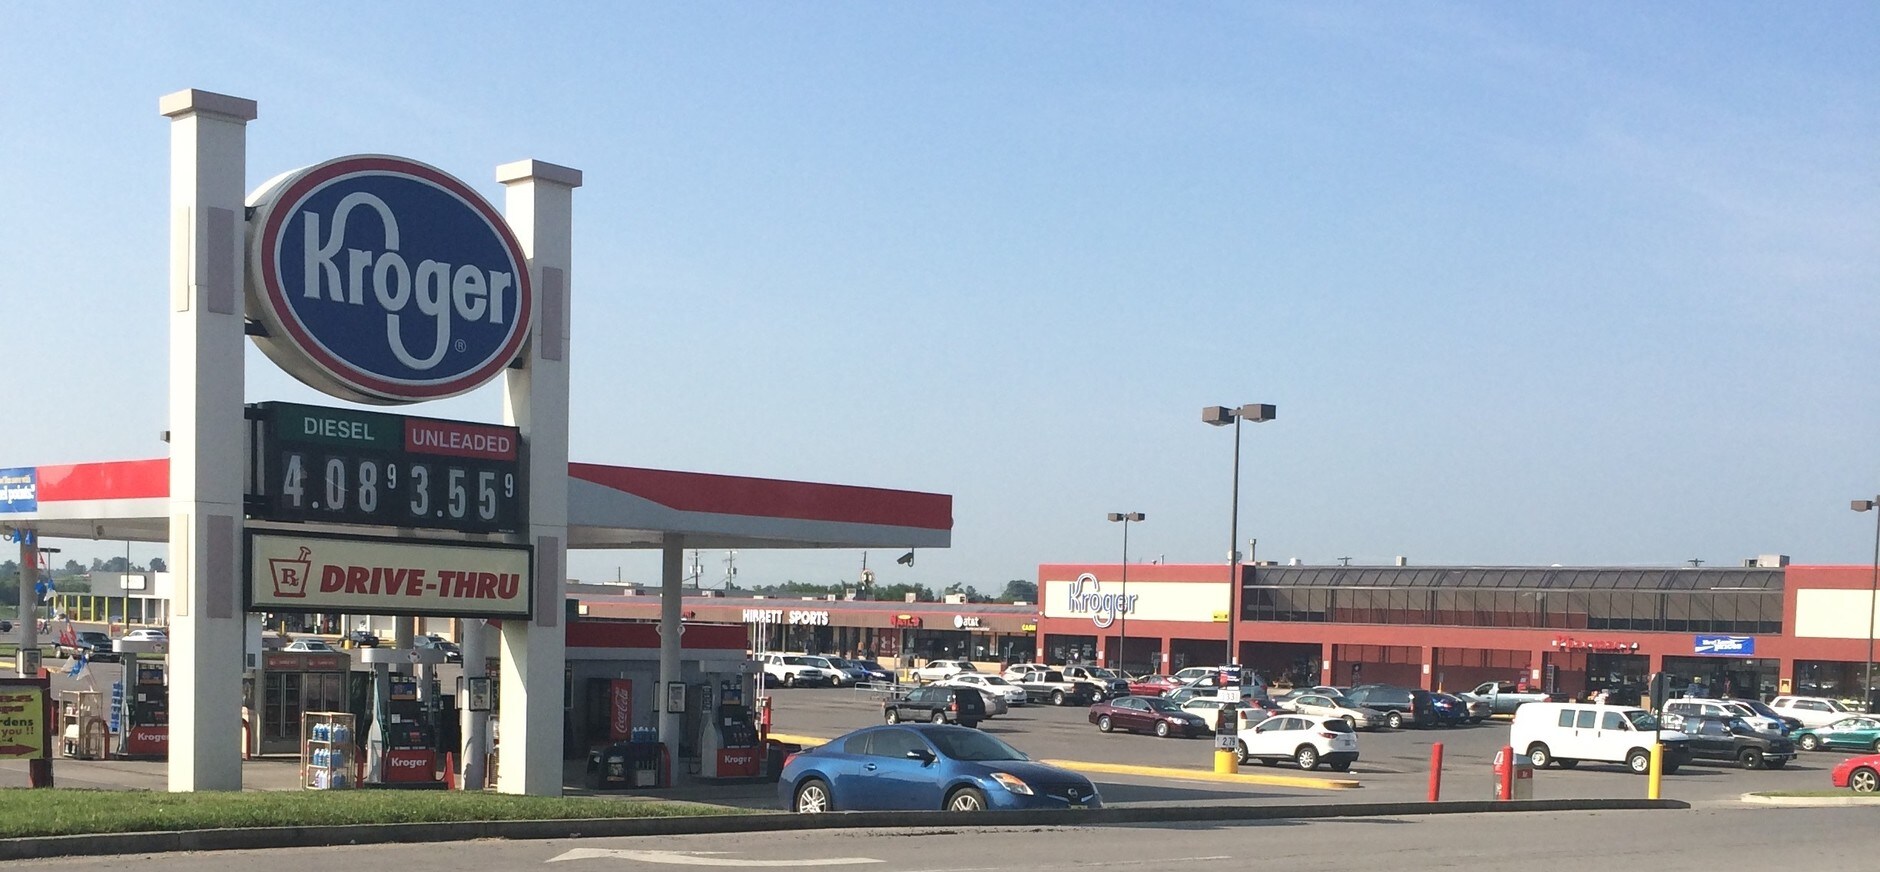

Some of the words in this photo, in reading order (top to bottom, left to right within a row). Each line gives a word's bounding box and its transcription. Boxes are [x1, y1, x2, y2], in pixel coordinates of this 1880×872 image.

[303, 192, 511, 370] Kroger
[304, 417, 375, 441] DIESEL
[412, 428, 510, 453] UNLEADED
[410, 465, 496, 520] 3.55
[320, 565, 520, 599] DRIVE-THRU
[1068, 573, 1138, 628] Kroger
[789, 610, 830, 626] SPORTS
[2, 728, 22, 738] you
[138, 733, 169, 742] Kroge
[391, 758, 427, 768] Kroger
[724, 755, 752, 765] Kroger
